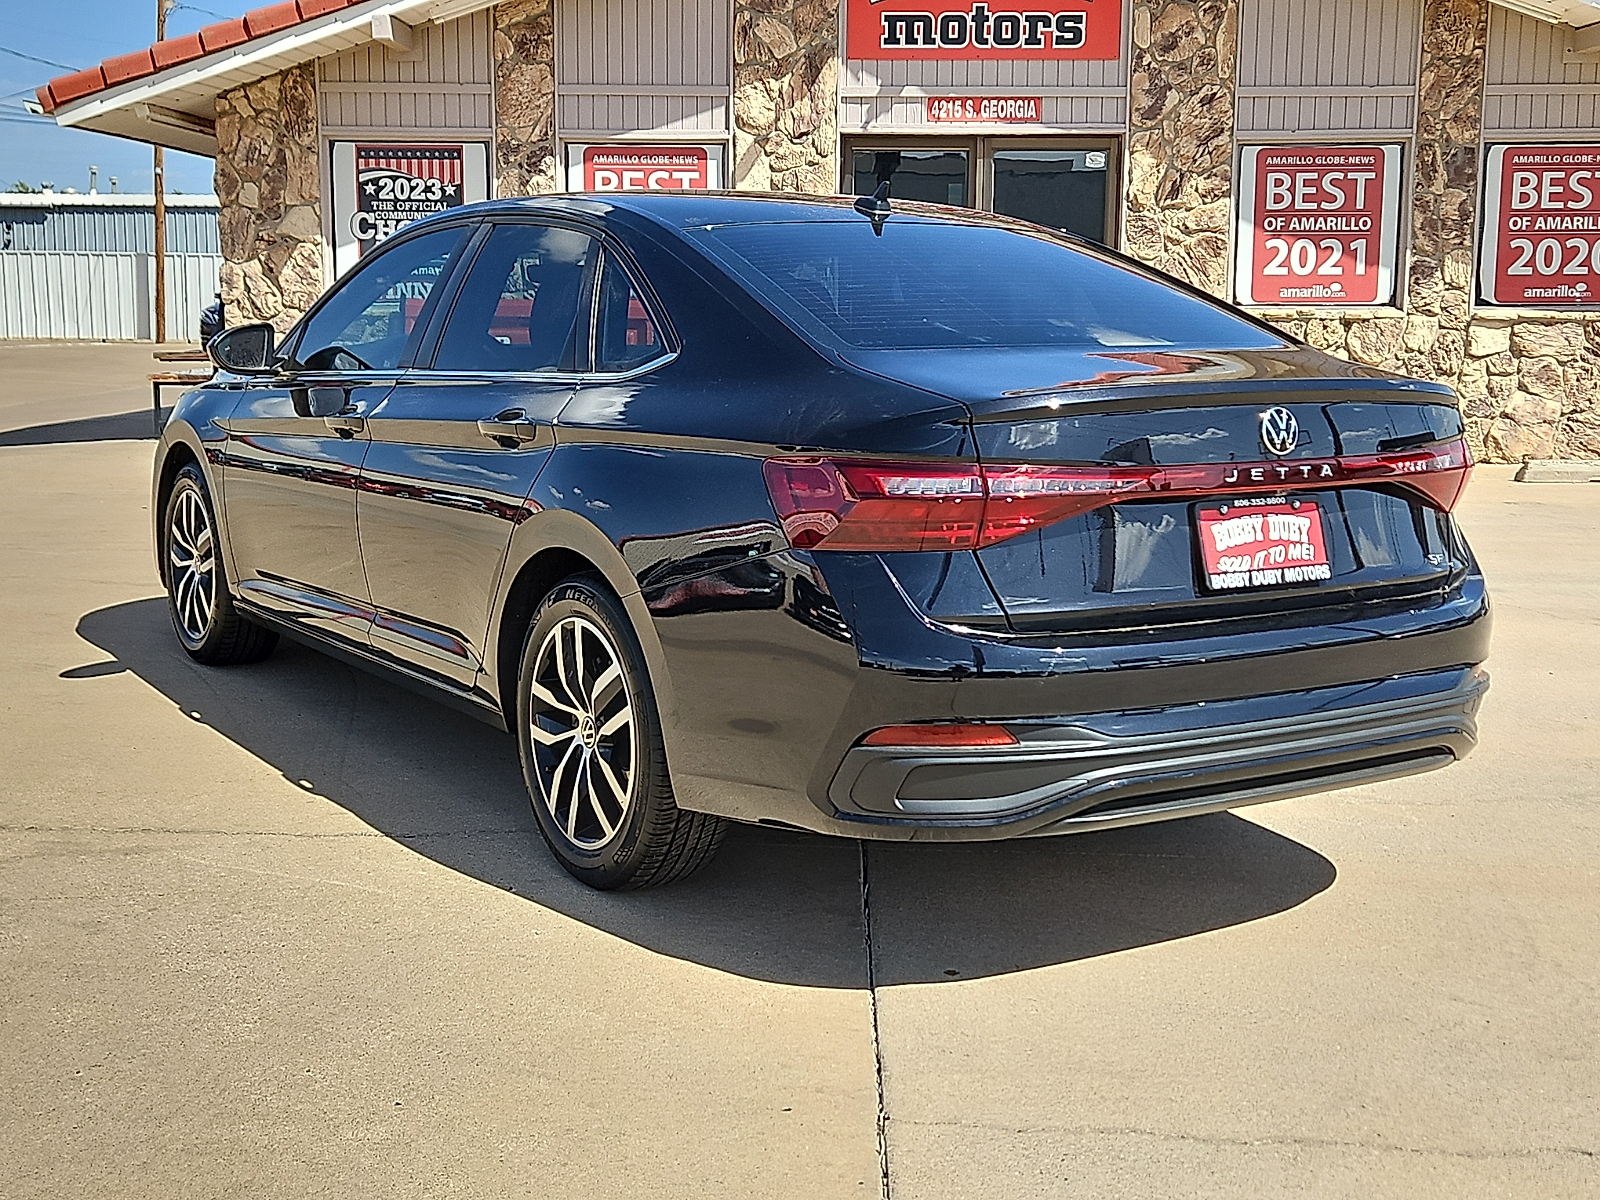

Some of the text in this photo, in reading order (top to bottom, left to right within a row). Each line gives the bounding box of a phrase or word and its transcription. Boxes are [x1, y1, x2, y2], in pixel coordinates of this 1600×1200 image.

[881, 2, 1087, 49] motors
[931, 99, 1037, 119] 4215 S. GEORGIA
[592, 154, 699, 164] AMARILLO GLOBE-NEWS
[1266, 156, 1376, 165] AMARILLO GLOBE-NEWS
[1512, 155, 1561, 164] AMARILLO
[378, 177, 442, 200] 2023
[1266, 172, 1376, 210] BEST
[1511, 171, 1600, 209] BES
[371, 201, 449, 212] THE OFFICIAL
[1263, 217, 1372, 231] OF AMARILLO
[1508, 216, 1531, 231] OF
[1262, 238, 1367, 276] 2021
[1279, 284, 1346, 298] amarillo.com
[1224, 464, 1334, 483] JETTA
[1210, 513, 1311, 552] BOBBY DUBY
[1253, 549, 1268, 571] IT
[1268, 543, 1286, 565] TO
[1288, 542, 1315, 562] ME!
[1211, 564, 1331, 590] BOBBY DUBY MOTORS
